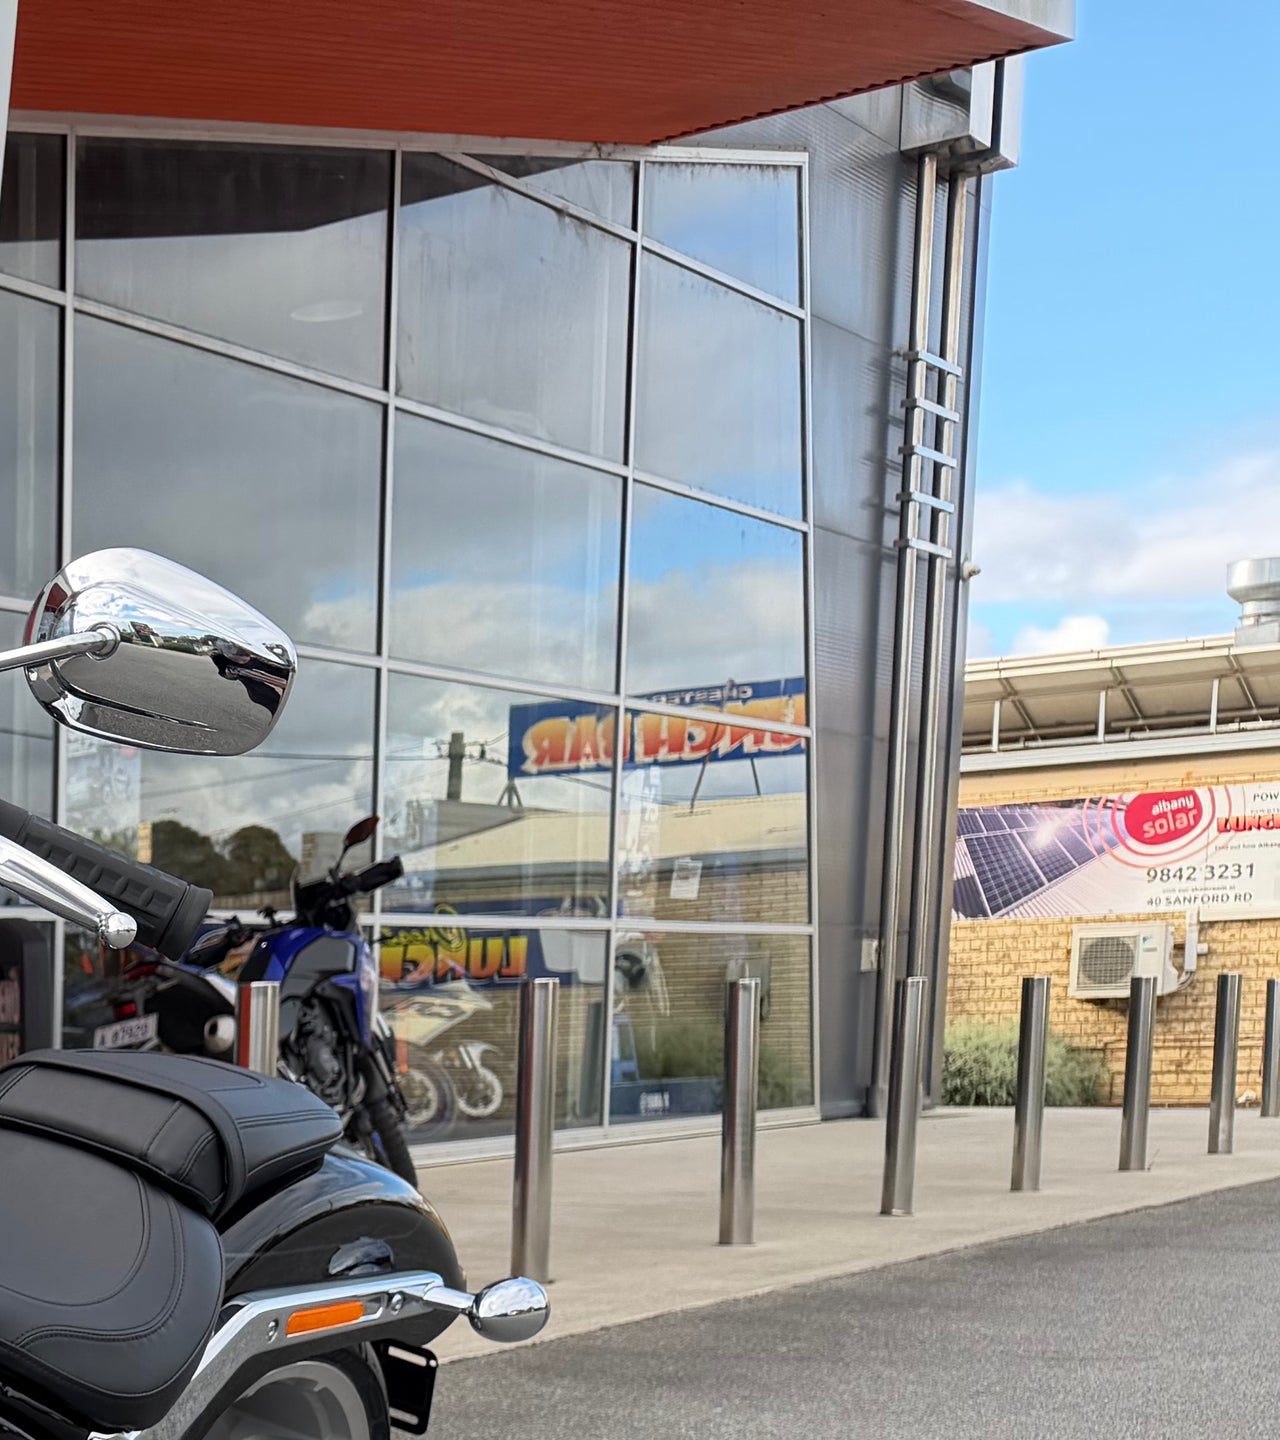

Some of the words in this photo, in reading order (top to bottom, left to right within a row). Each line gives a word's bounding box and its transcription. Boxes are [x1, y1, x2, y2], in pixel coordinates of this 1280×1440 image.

[1152, 795, 1194, 815] albany
[1143, 809, 1198, 838] solar
[1147, 866, 1197, 883] 9842
[1204, 863, 1254, 881] 3231
[1166, 894, 1230, 905] SANFORD
[1234, 892, 1252, 902] RD
